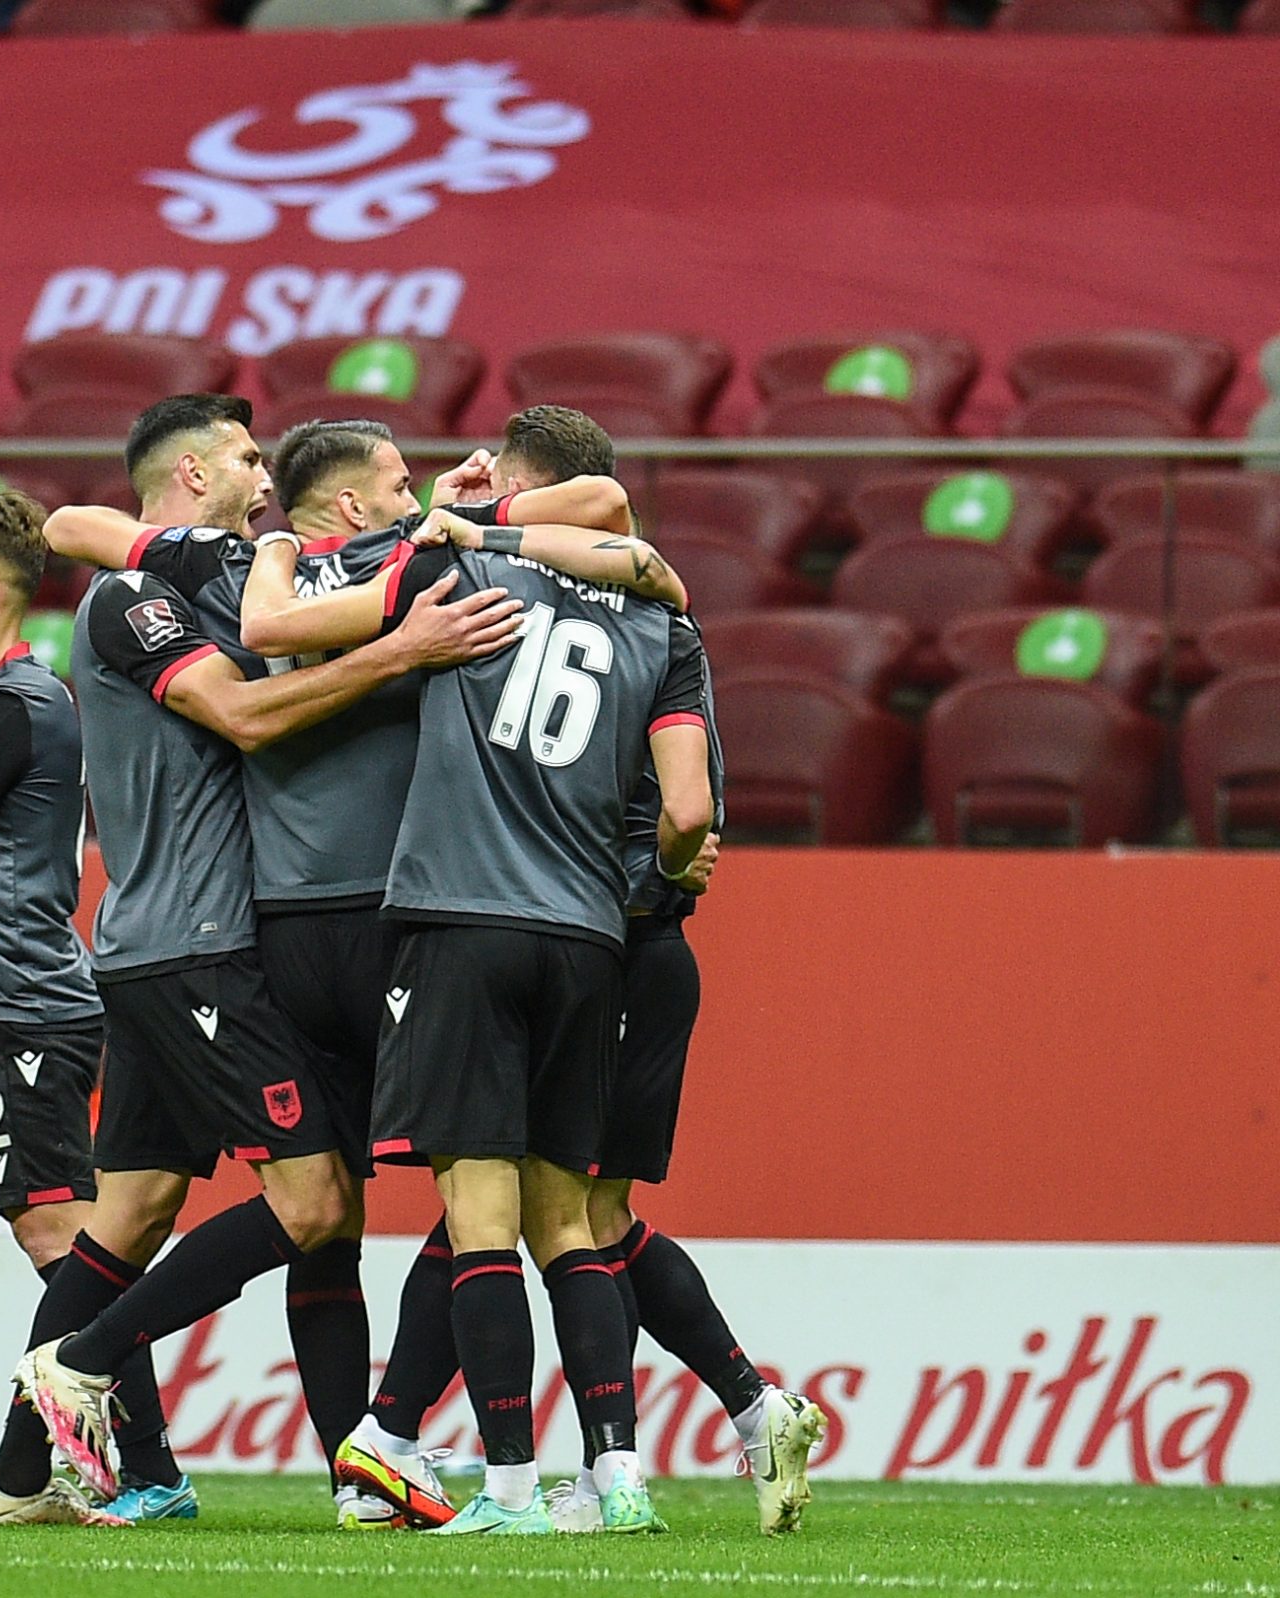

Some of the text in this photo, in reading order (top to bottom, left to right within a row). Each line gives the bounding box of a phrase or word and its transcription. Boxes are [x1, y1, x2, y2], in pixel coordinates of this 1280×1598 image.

[488, 600, 614, 767] 16
[488, 1395, 529, 1412] FSHF
[586, 1381, 625, 1400] FSHF
[881, 1314, 1253, 1485] piłka
